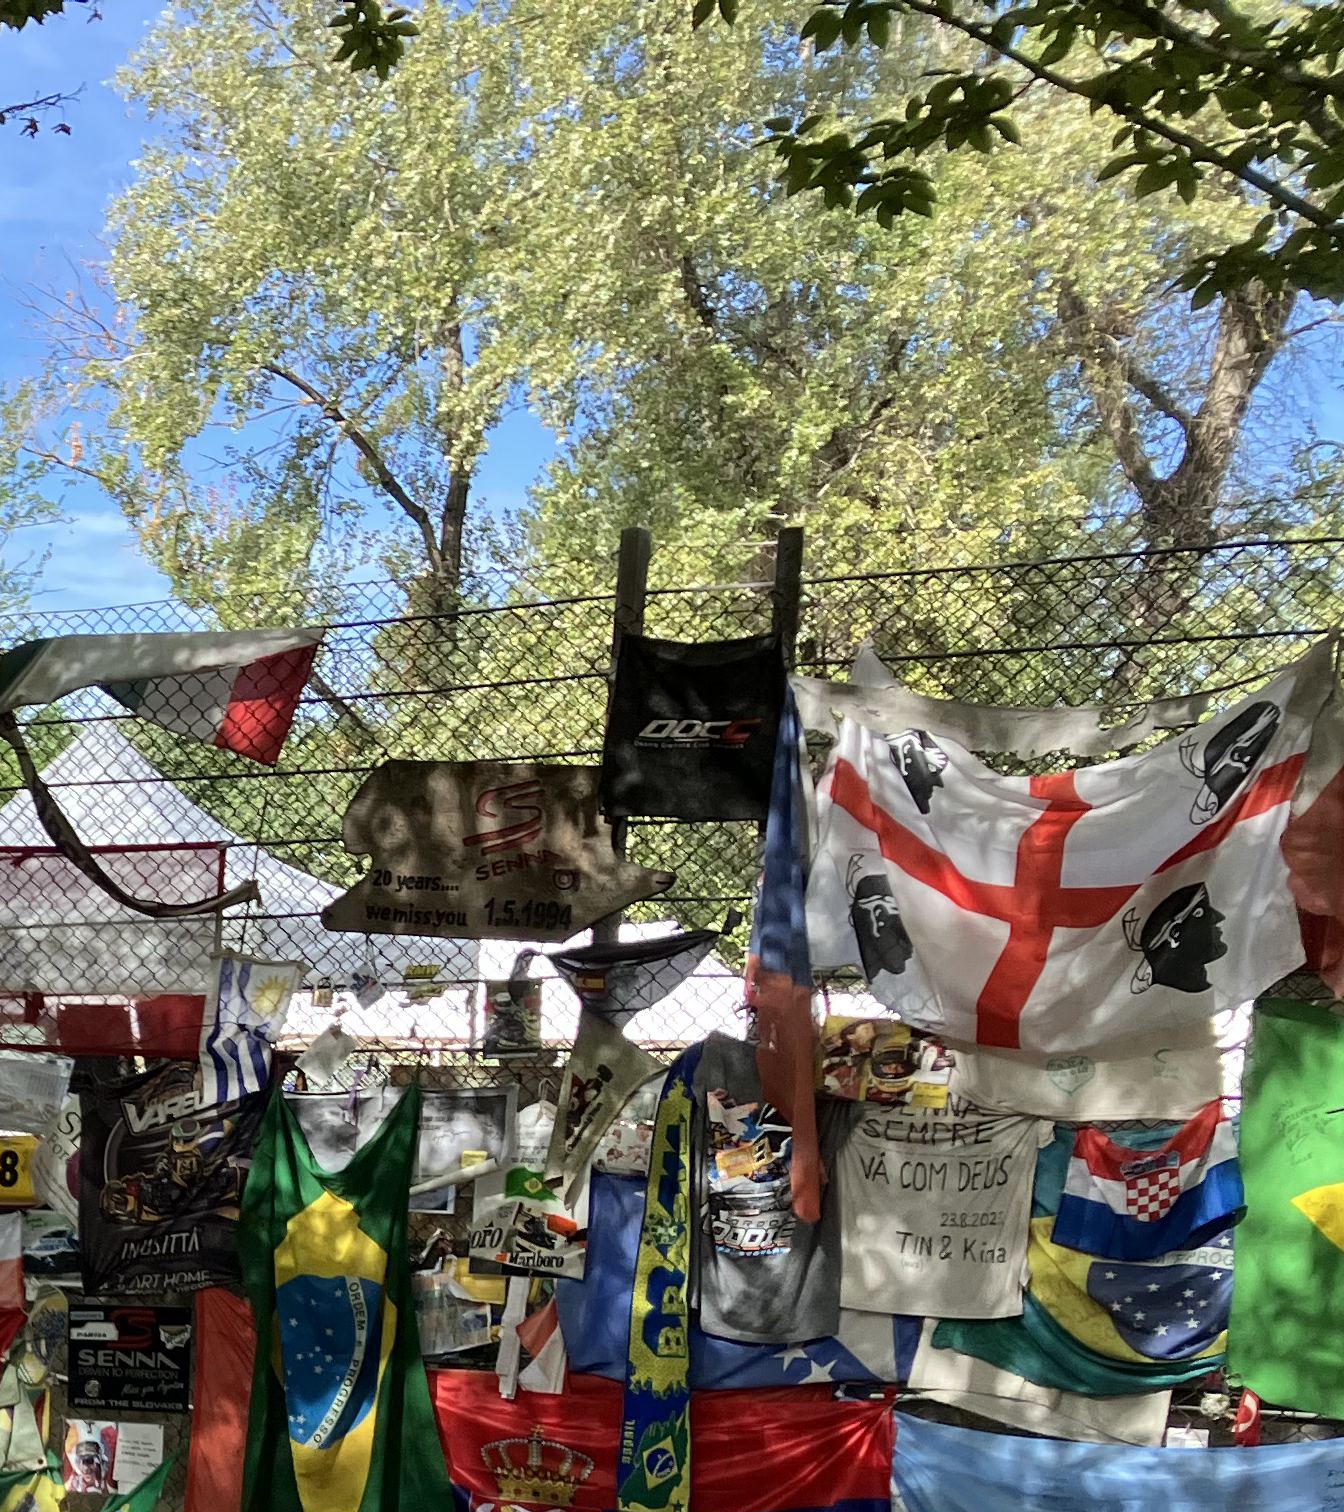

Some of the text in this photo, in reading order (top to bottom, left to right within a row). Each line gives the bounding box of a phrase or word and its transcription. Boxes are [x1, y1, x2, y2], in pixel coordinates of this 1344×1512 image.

[373, 869, 392, 886] 20
[476, 850, 564, 881] SENNA
[484, 897, 573, 930] 1.5.1994
[862, 1118, 995, 1147] SEMPRE
[900, 1160, 947, 1192] COM
[957, 1155, 1013, 1192] DEUS
[940, 1210, 1005, 1228] 23.8.202
[509, 1251, 564, 1269] Marlboro
[895, 1230, 932, 1257] TIN
[938, 1234, 953, 1261] &
[348, 1281, 368, 1331] ORDEM
[77, 1349, 181, 1370] SENNA
[313, 1359, 360, 1444] PROGRESSO
